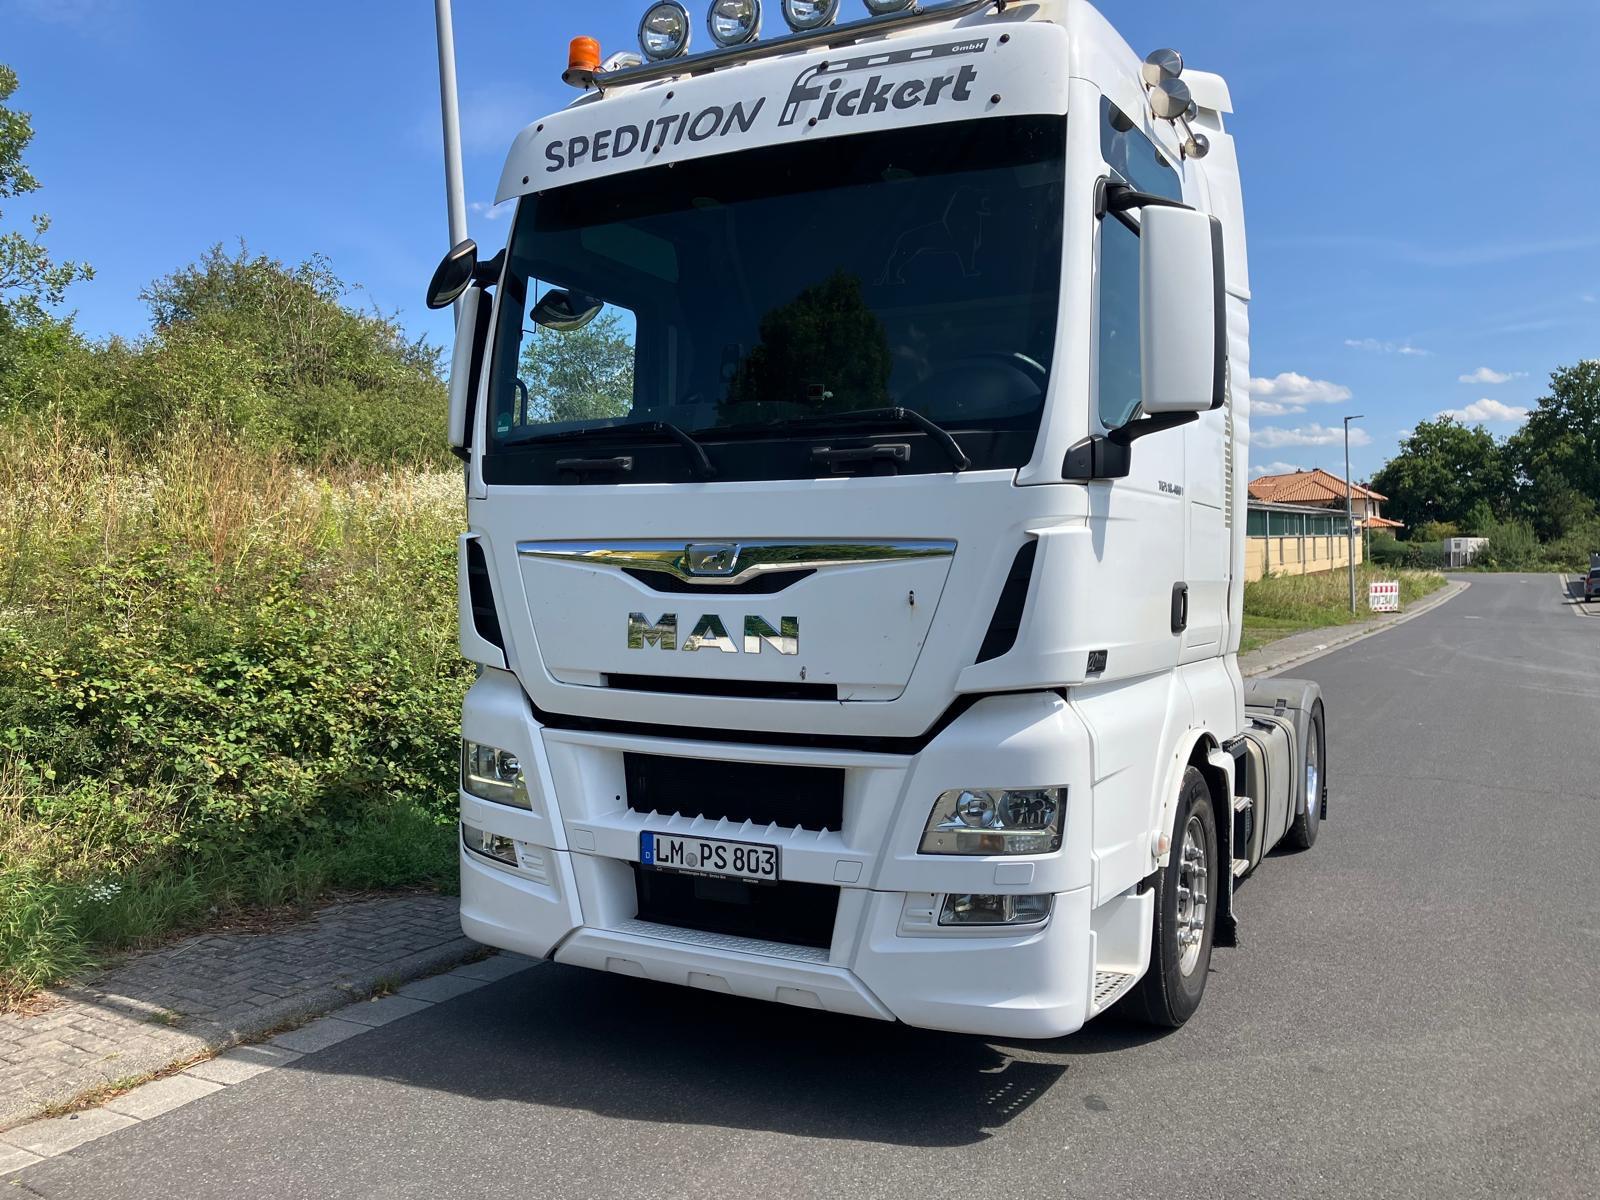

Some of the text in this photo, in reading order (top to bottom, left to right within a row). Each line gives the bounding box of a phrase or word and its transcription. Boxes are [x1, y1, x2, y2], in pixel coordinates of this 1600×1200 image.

[952, 42, 984, 52] GmbH
[545, 62, 977, 173] SPEDITION Fickert
[628, 612, 799, 655] MAN
[645, 851, 651, 859] D
[656, 838, 684, 865] LM
[700, 843, 728, 870] PS
[733, 847, 775, 875] 803
